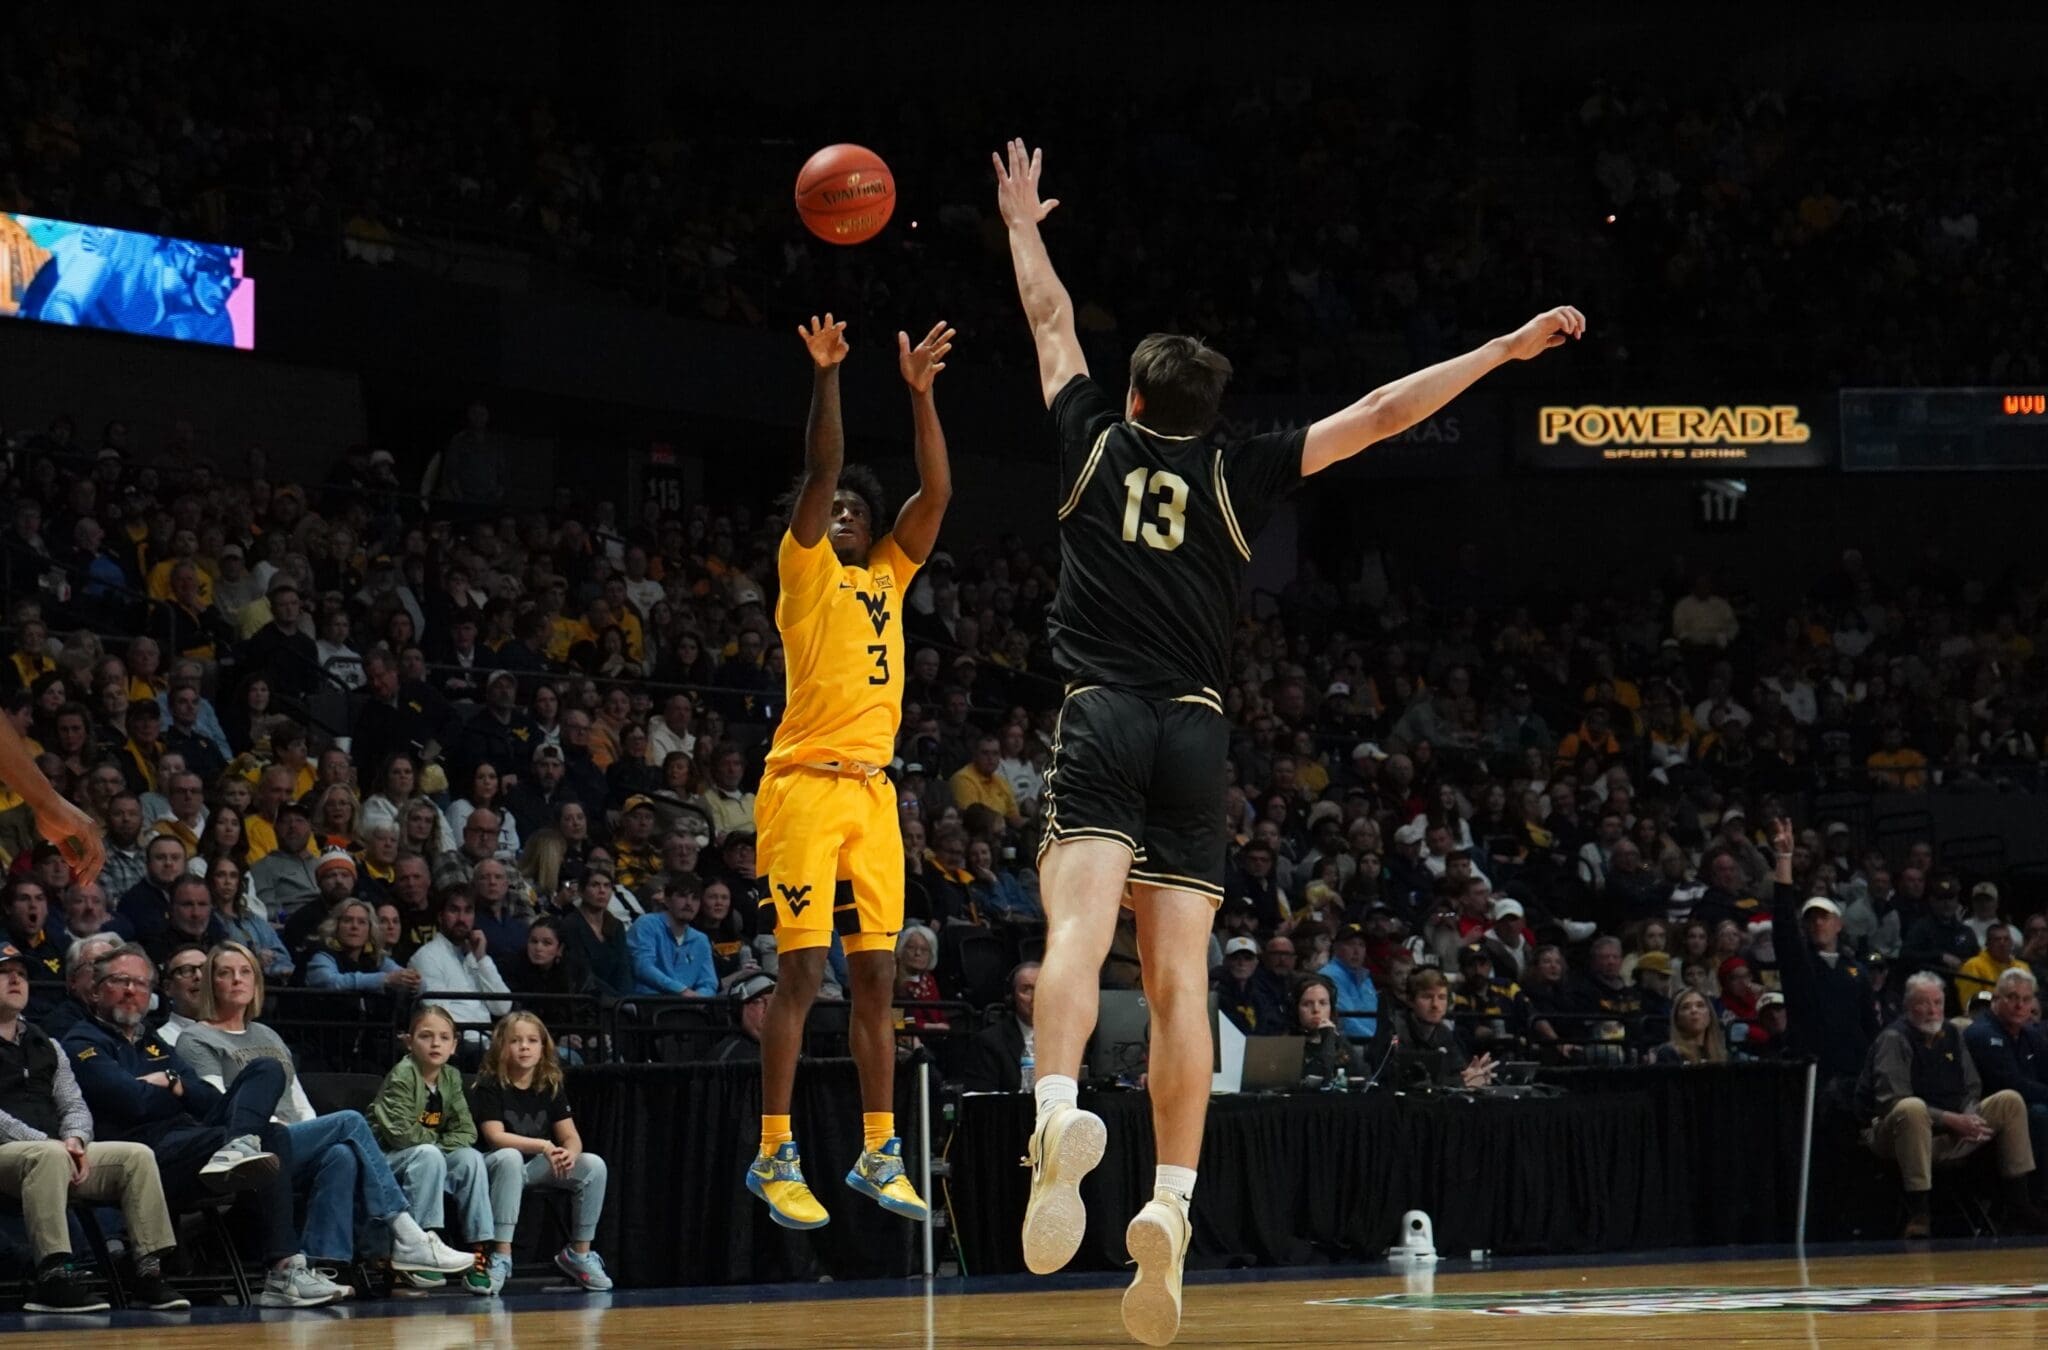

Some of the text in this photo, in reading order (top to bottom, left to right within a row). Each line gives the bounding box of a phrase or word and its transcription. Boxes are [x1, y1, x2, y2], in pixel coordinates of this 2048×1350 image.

[1602, 448, 1748, 460] SPORTS DRINK
[1122, 467, 1190, 552] 13
[867, 644, 890, 685] 3
